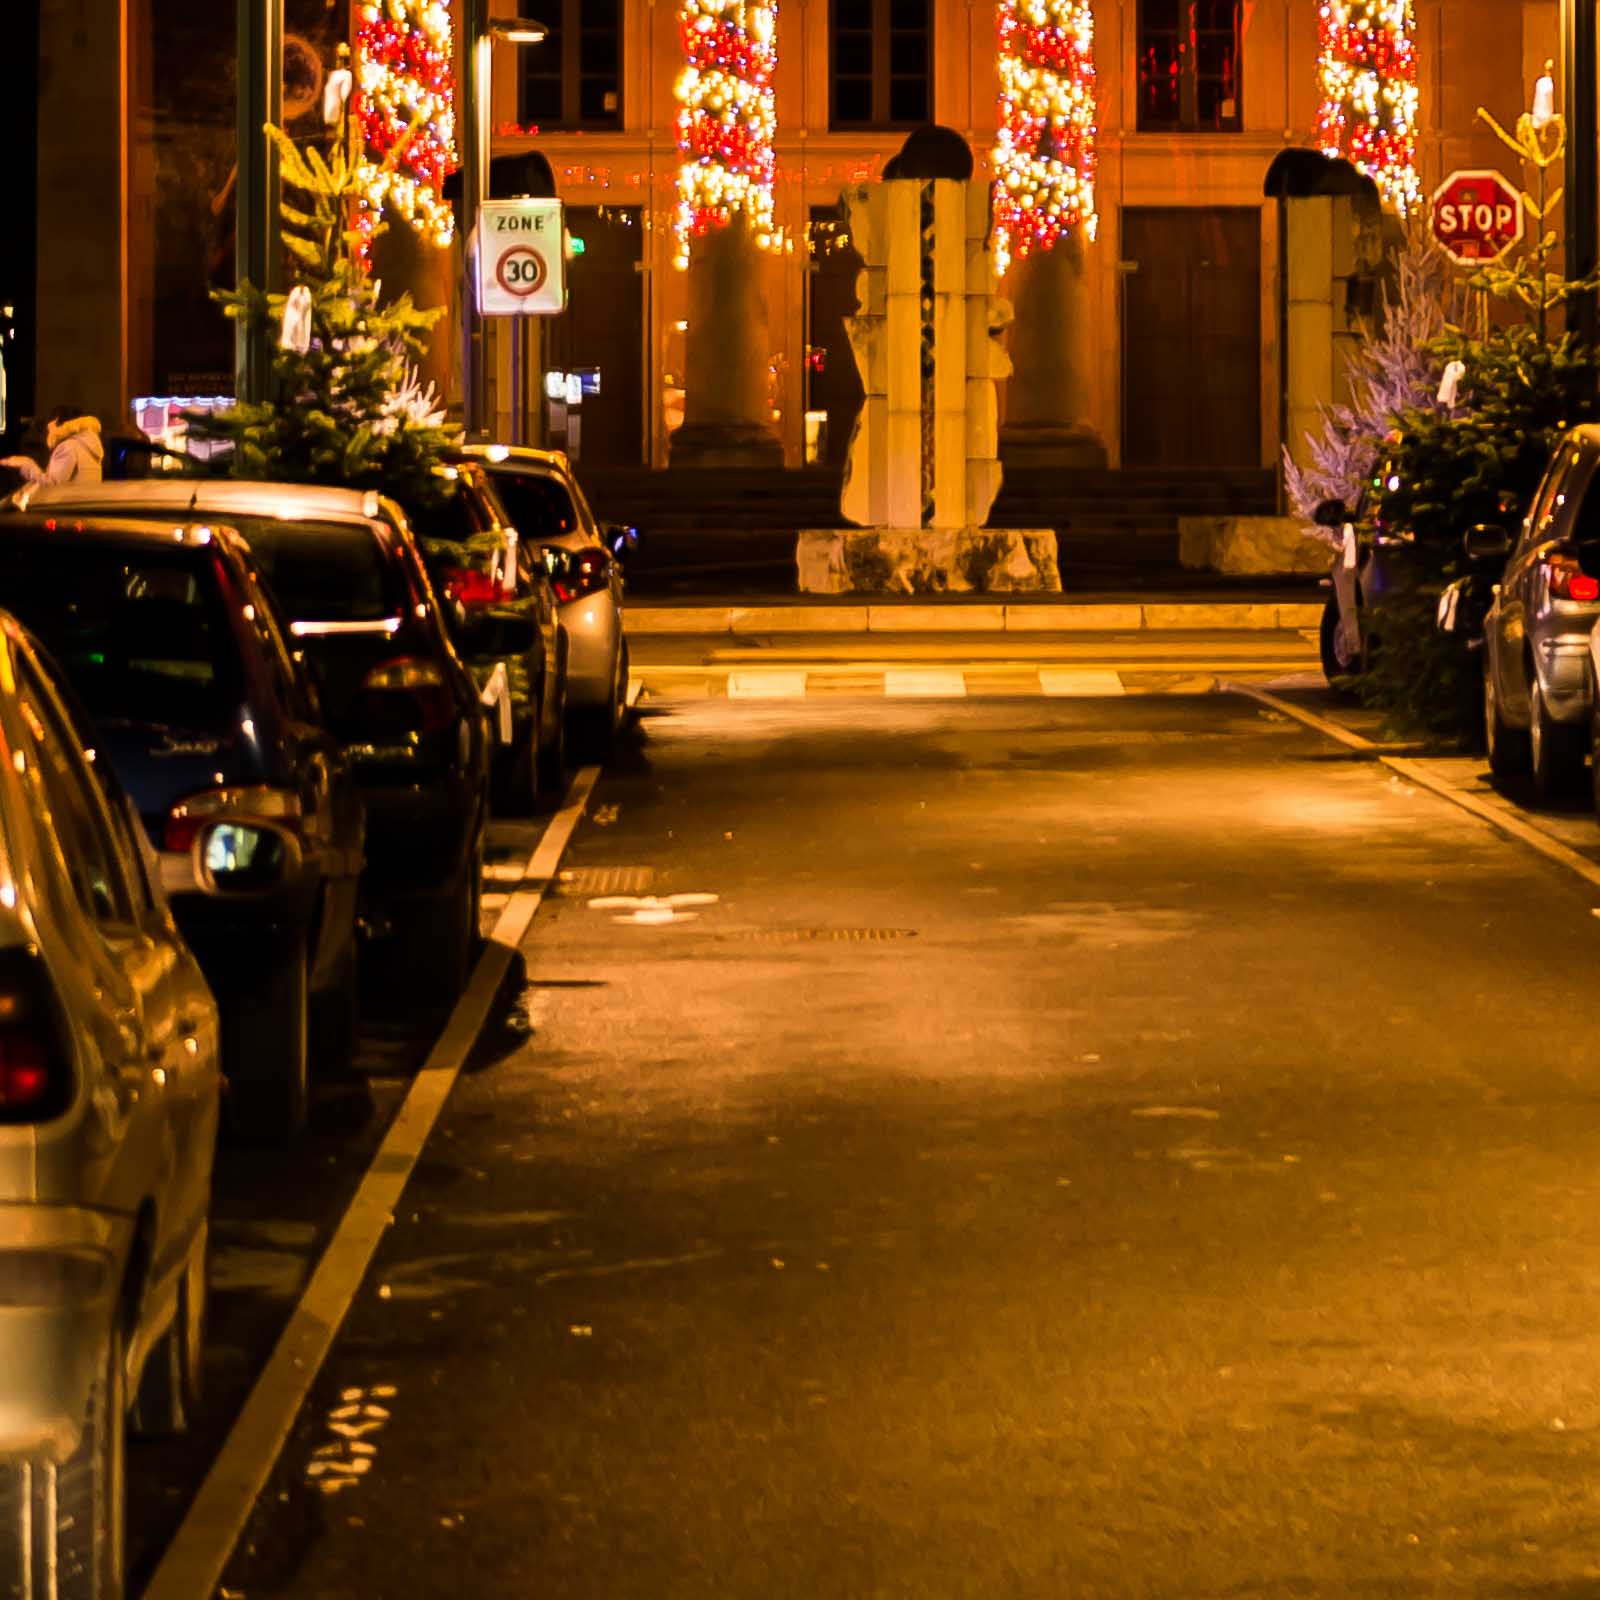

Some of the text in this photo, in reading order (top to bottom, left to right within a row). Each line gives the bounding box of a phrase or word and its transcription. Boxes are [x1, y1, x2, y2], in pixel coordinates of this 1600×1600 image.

[497, 216, 544, 231] ZONE
[1439, 204, 1512, 232] STOP
[506, 260, 538, 282] 30
